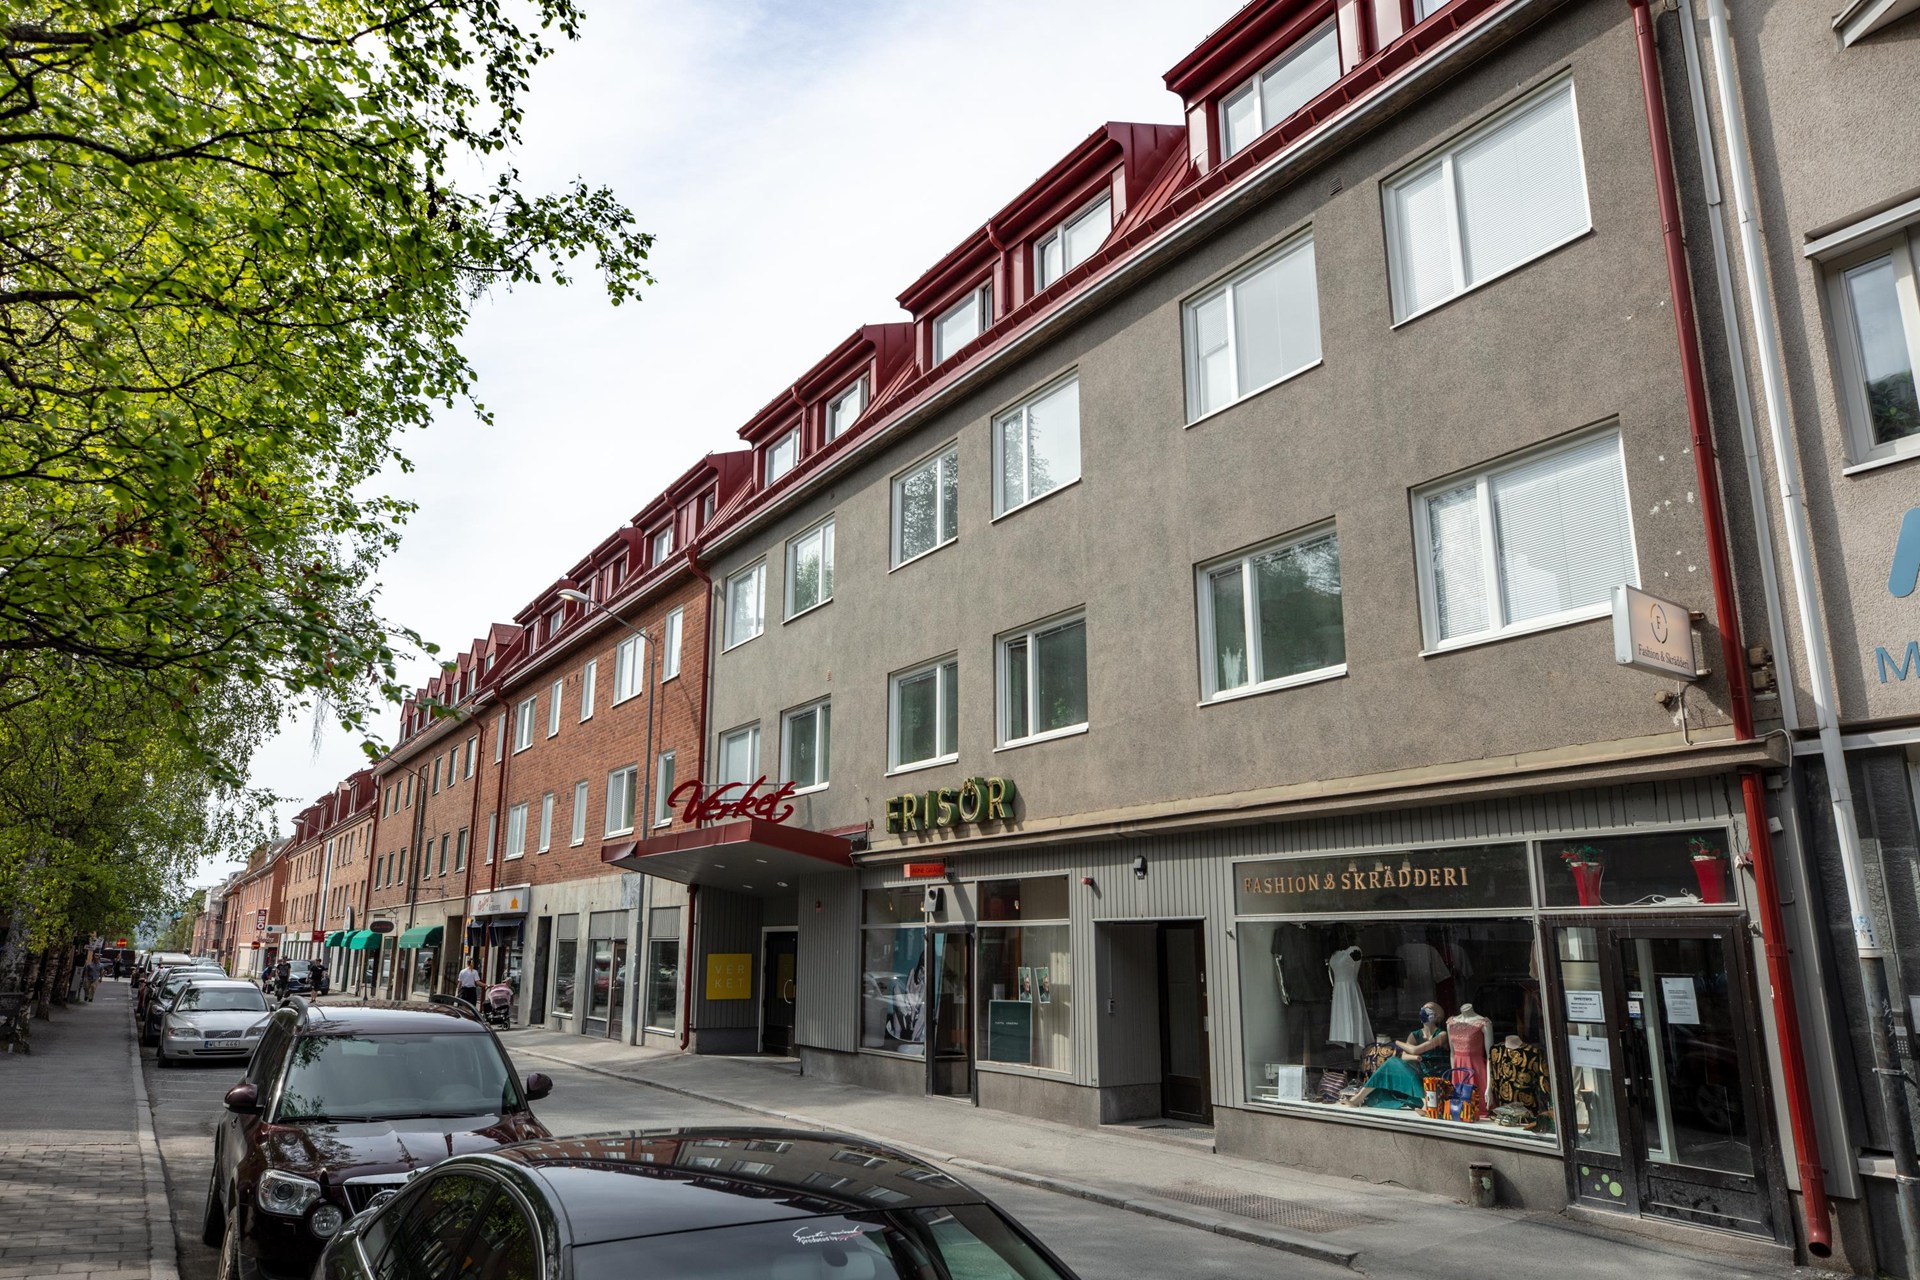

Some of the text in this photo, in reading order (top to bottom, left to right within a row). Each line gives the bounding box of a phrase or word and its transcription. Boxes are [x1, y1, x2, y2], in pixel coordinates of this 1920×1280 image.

[1638, 643, 1660, 661] Fashion
[1660, 651, 1666, 662] &
[667, 775, 795, 823] Verket
[886, 776, 1015, 834] FRISÖR
[1244, 865, 1468, 894] FASHION & SKRÄDDERI
[715, 964, 745, 975] VER
[715, 978, 744, 989] KET
